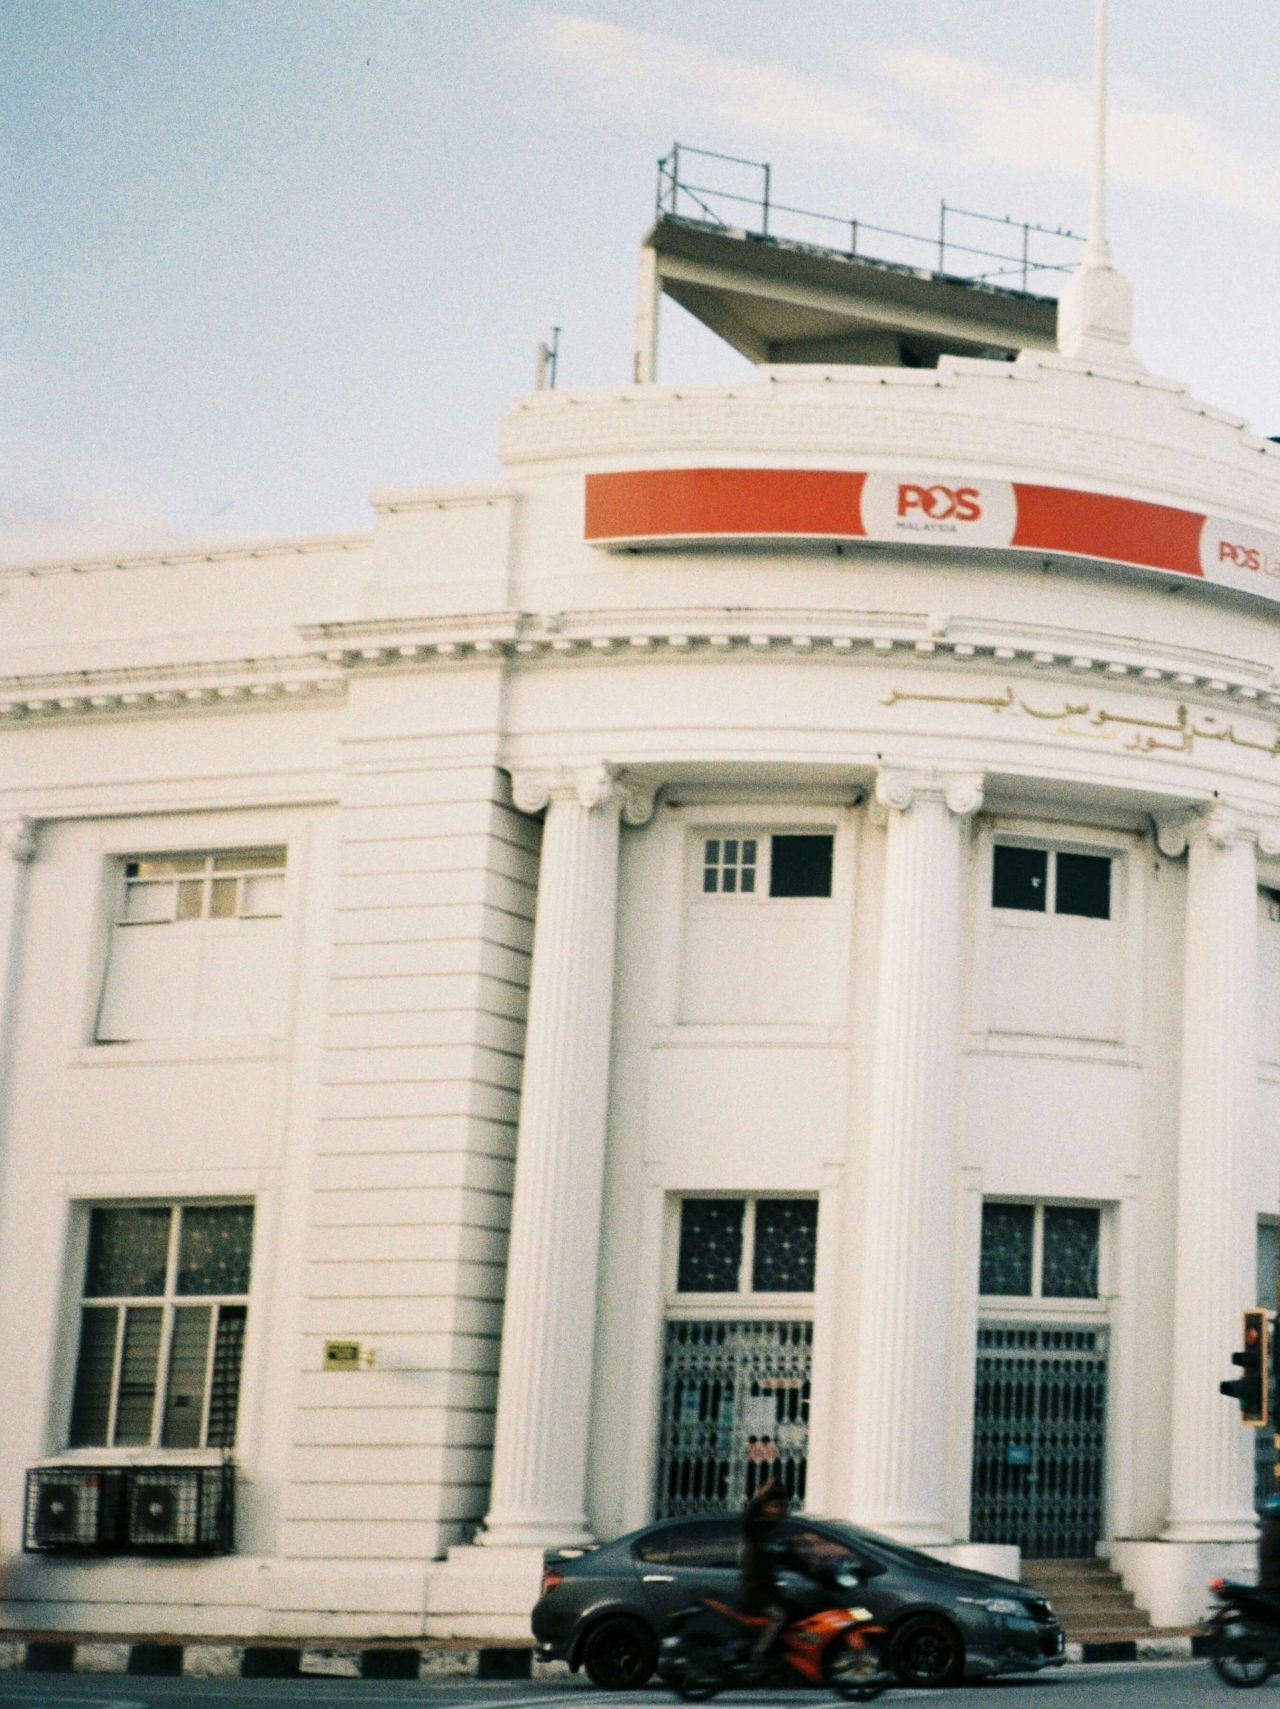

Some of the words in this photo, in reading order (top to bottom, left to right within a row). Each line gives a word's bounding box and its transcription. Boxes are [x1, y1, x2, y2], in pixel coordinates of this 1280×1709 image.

[898, 483, 982, 522] POS
[896, 521, 958, 533] MALAYSIA
[1218, 540, 1260, 572] POS
